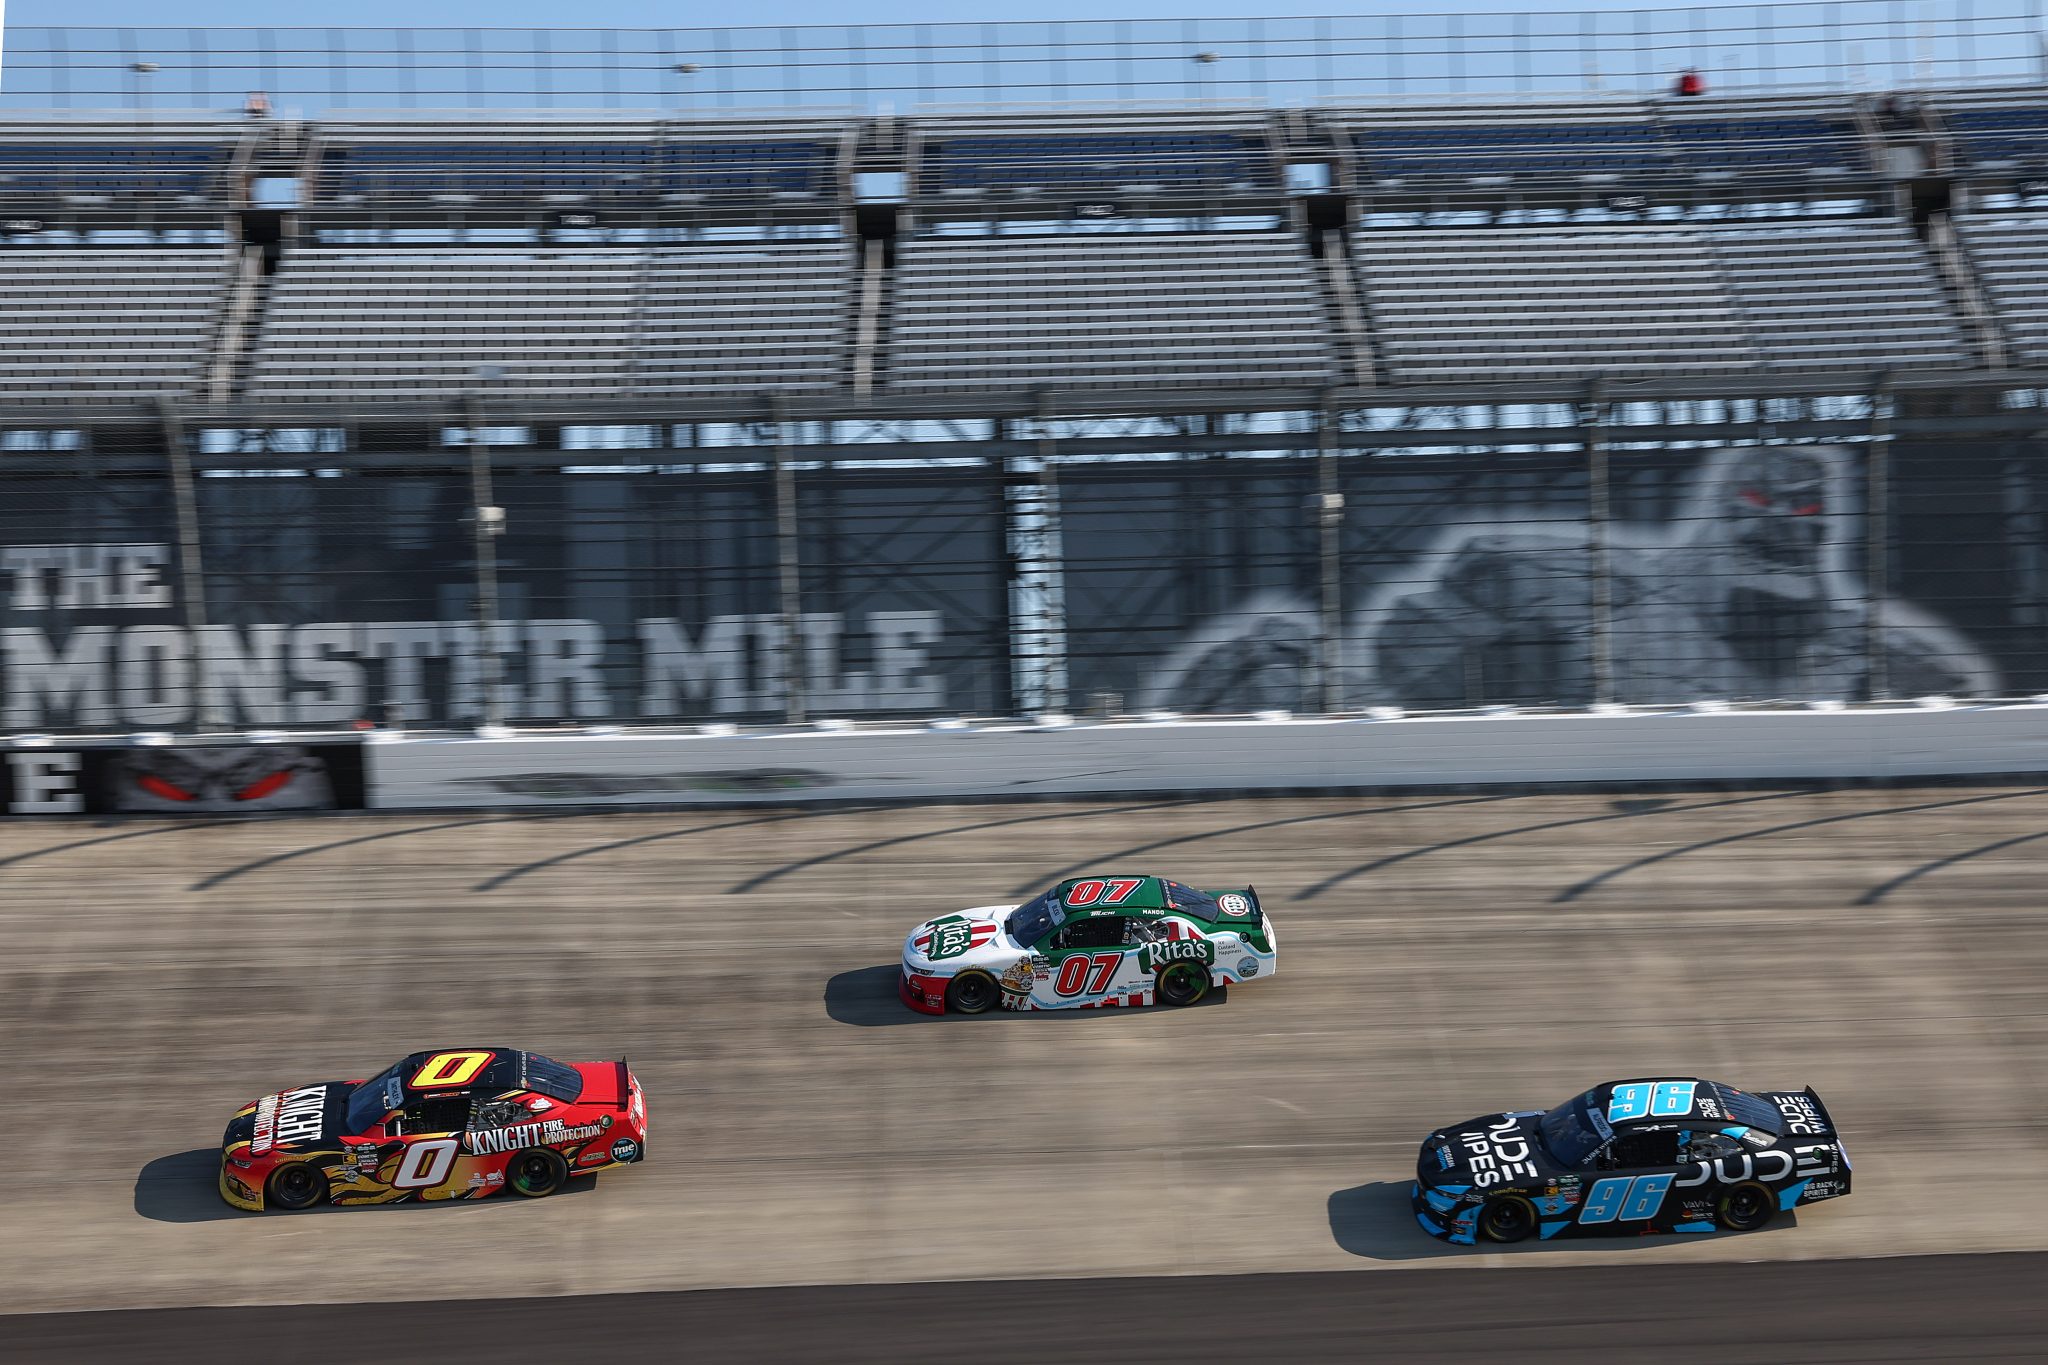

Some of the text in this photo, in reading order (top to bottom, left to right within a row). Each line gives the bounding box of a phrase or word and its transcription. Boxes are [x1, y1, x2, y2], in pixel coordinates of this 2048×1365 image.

[4, 543, 172, 611] THE
[0, 610, 944, 728] MONSTER MILE
[1065, 878, 1143, 907] 07
[1147, 938, 1208, 966] Rita's
[1055, 951, 1124, 997] 07
[408, 1052, 496, 1090] 0
[276, 1085, 327, 1144] KNIGHT
[1608, 1081, 1699, 1124] 96
[1706, 1098, 1721, 1118] WIPES
[1794, 1096, 1827, 1134] WIPES
[471, 1123, 541, 1155] KNIGHT
[543, 1119, 565, 1133] FIRE
[544, 1124, 601, 1144] PROTECTION
[391, 1138, 459, 1189] 0
[613, 1143, 635, 1156] True
[1460, 1131, 1501, 1188] IPES
[1829, 1143, 1839, 1174] WIPES
[1578, 1173, 1677, 1224] 96
[1803, 1182, 1815, 1191] BIG
[1803, 1189, 1829, 1198] SPIRITS
